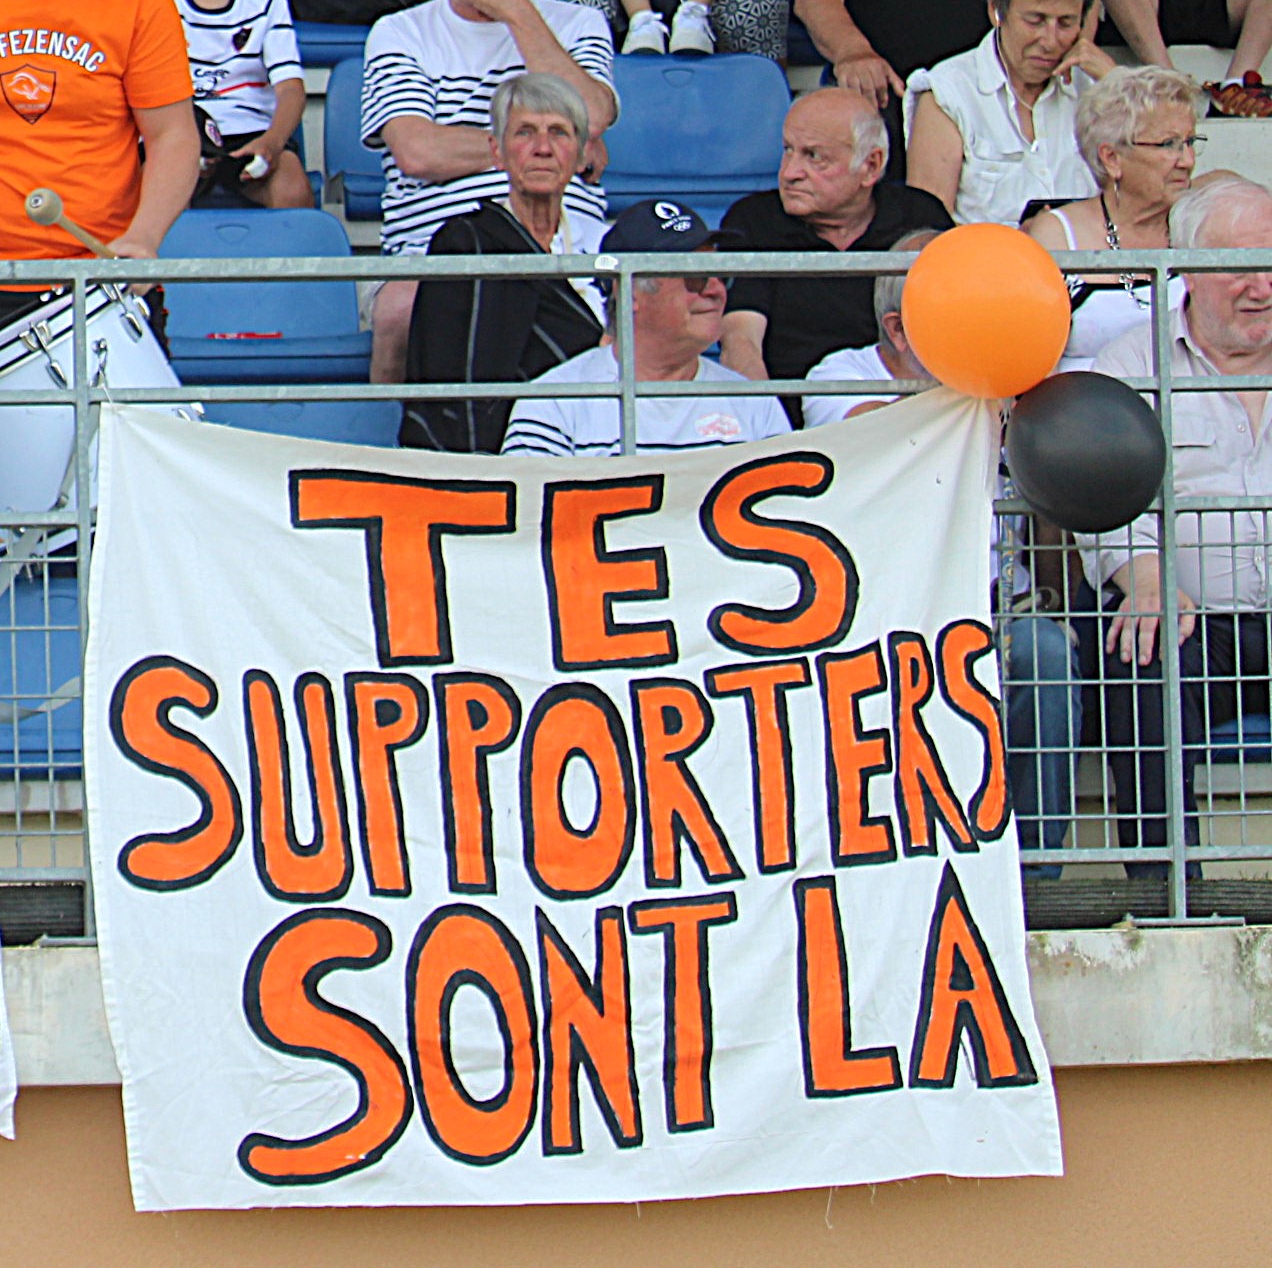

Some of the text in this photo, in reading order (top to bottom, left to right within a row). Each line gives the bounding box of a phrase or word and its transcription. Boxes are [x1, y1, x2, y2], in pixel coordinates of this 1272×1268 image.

[288, 451, 860, 673] TES
[109, 618, 1013, 905] SUPPORTERS
[237, 860, 1041, 1188] SONT LA
